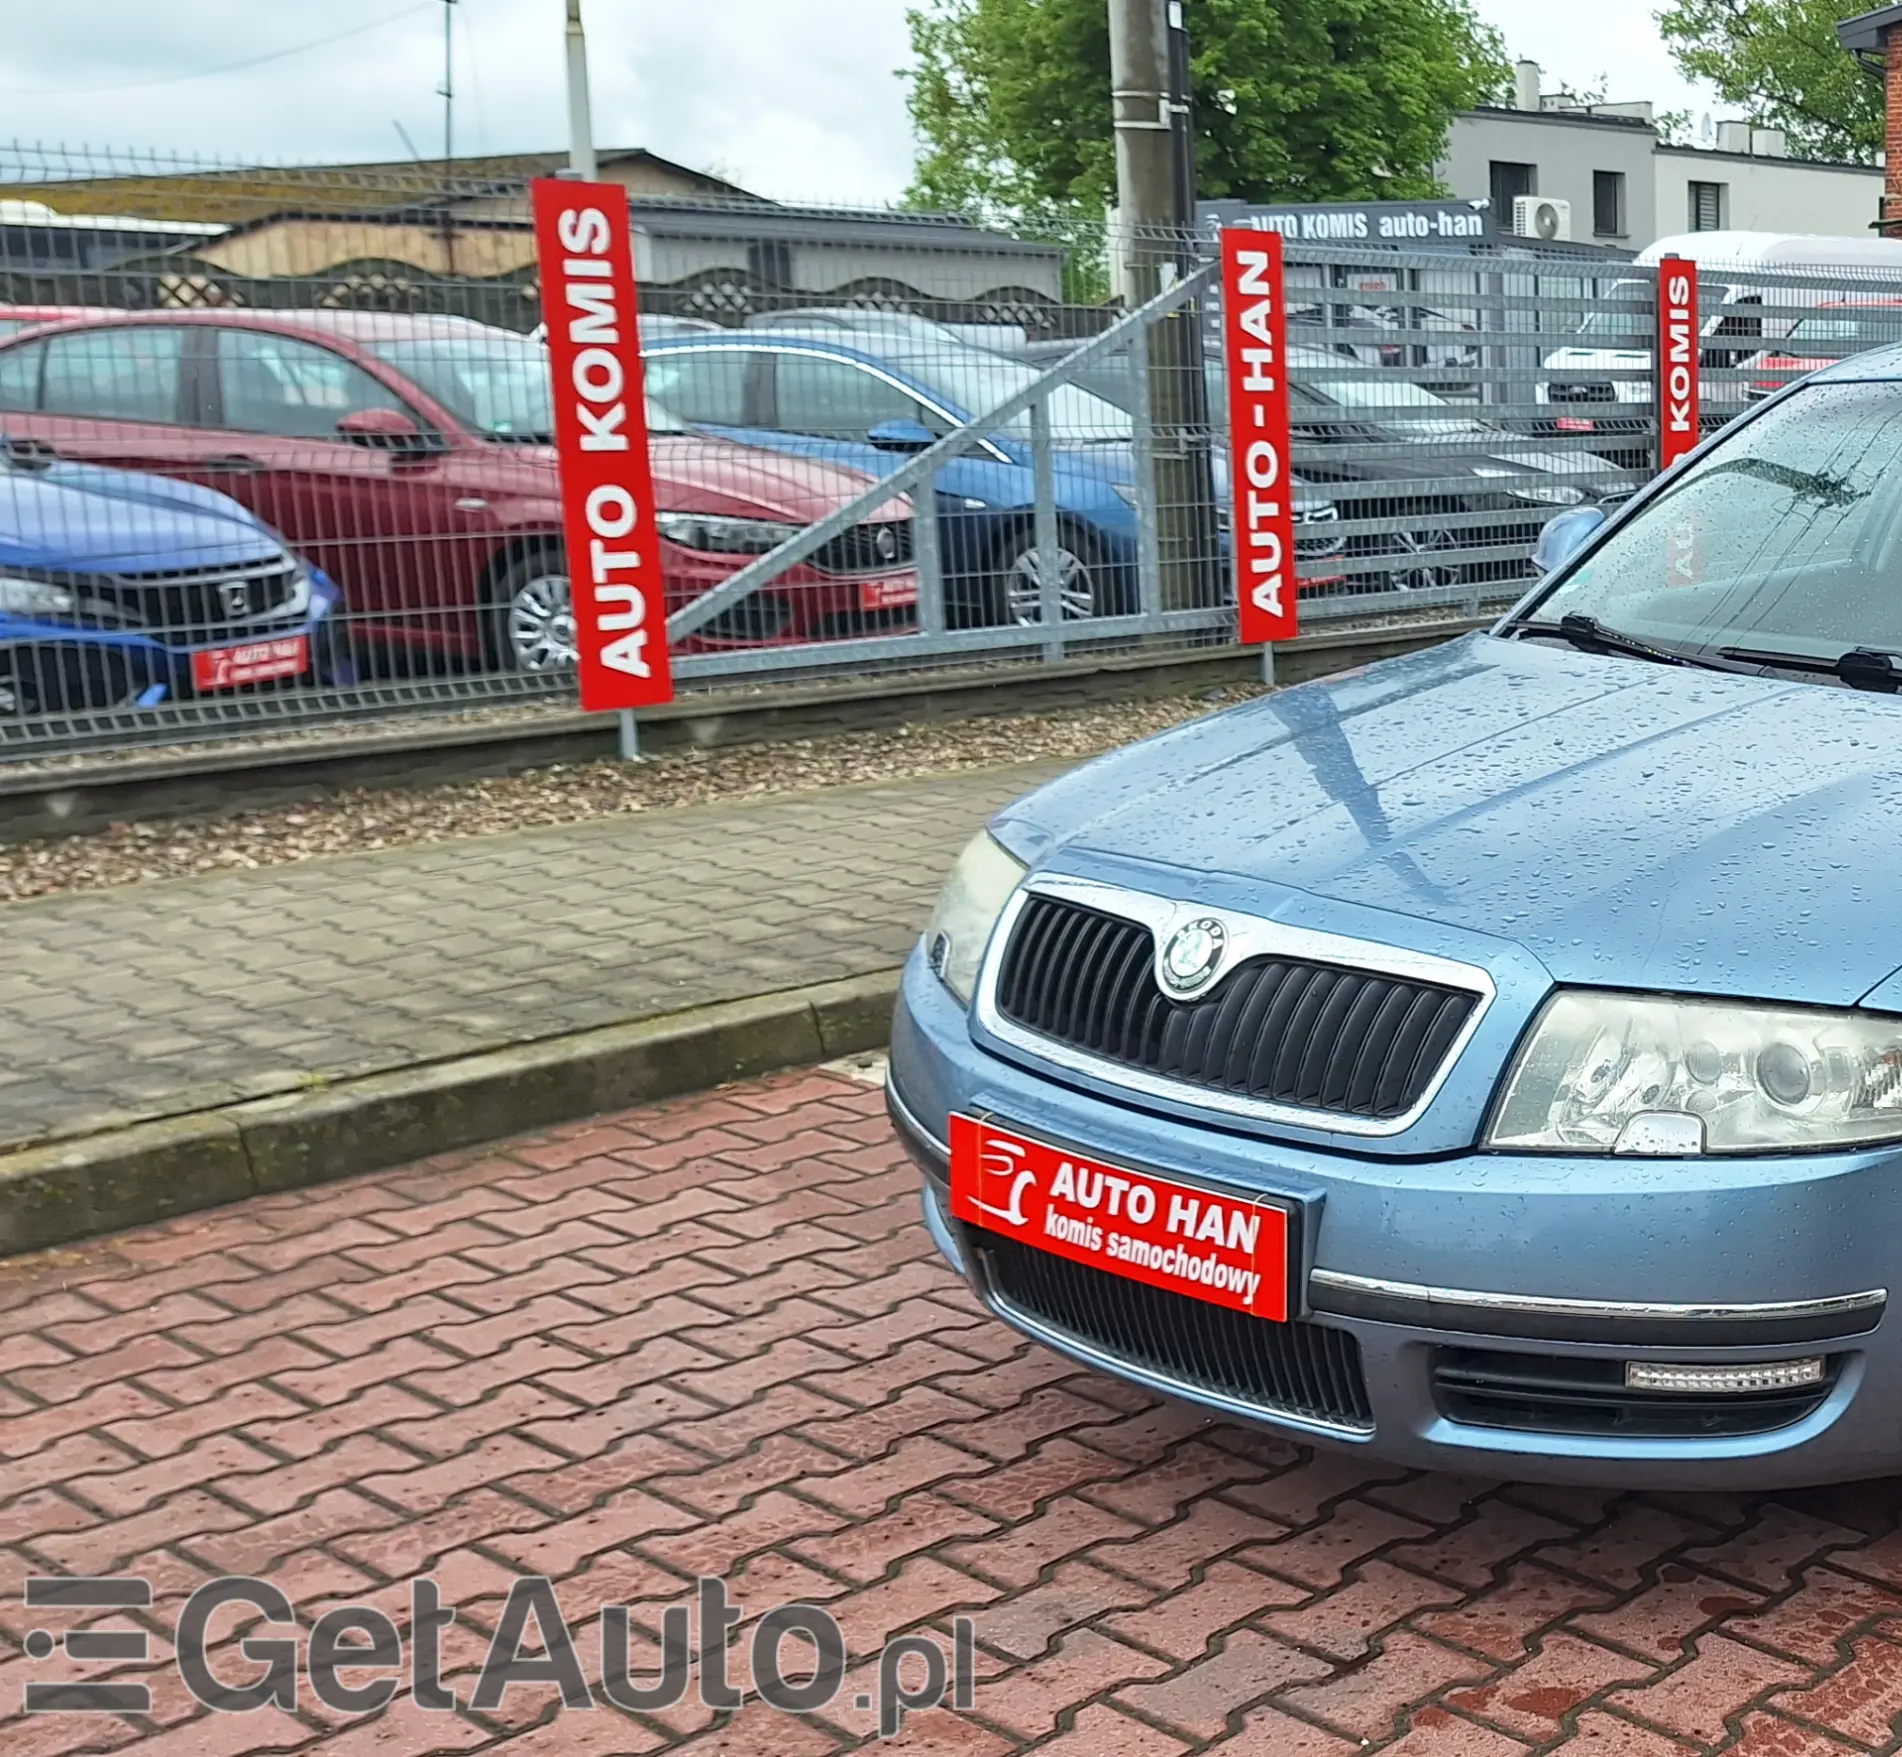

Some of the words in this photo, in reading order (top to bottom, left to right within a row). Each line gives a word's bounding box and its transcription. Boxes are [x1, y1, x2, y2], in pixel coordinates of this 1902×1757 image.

[1250, 214, 1298, 239] AUTO
[1302, 212, 1369, 240] KOMIS
[1379, 210, 1484, 238] auto-han
[557, 206, 629, 451] KOMIS
[1669, 275, 1690, 432] KOMIS
[584, 484, 651, 679] AUTO
[1044, 1203, 1104, 1252] komis
[1105, 1231, 1261, 1305] samochodowy
[1050, 1161, 1156, 1224] AUTO
[1166, 1195, 1261, 1253] HAN
